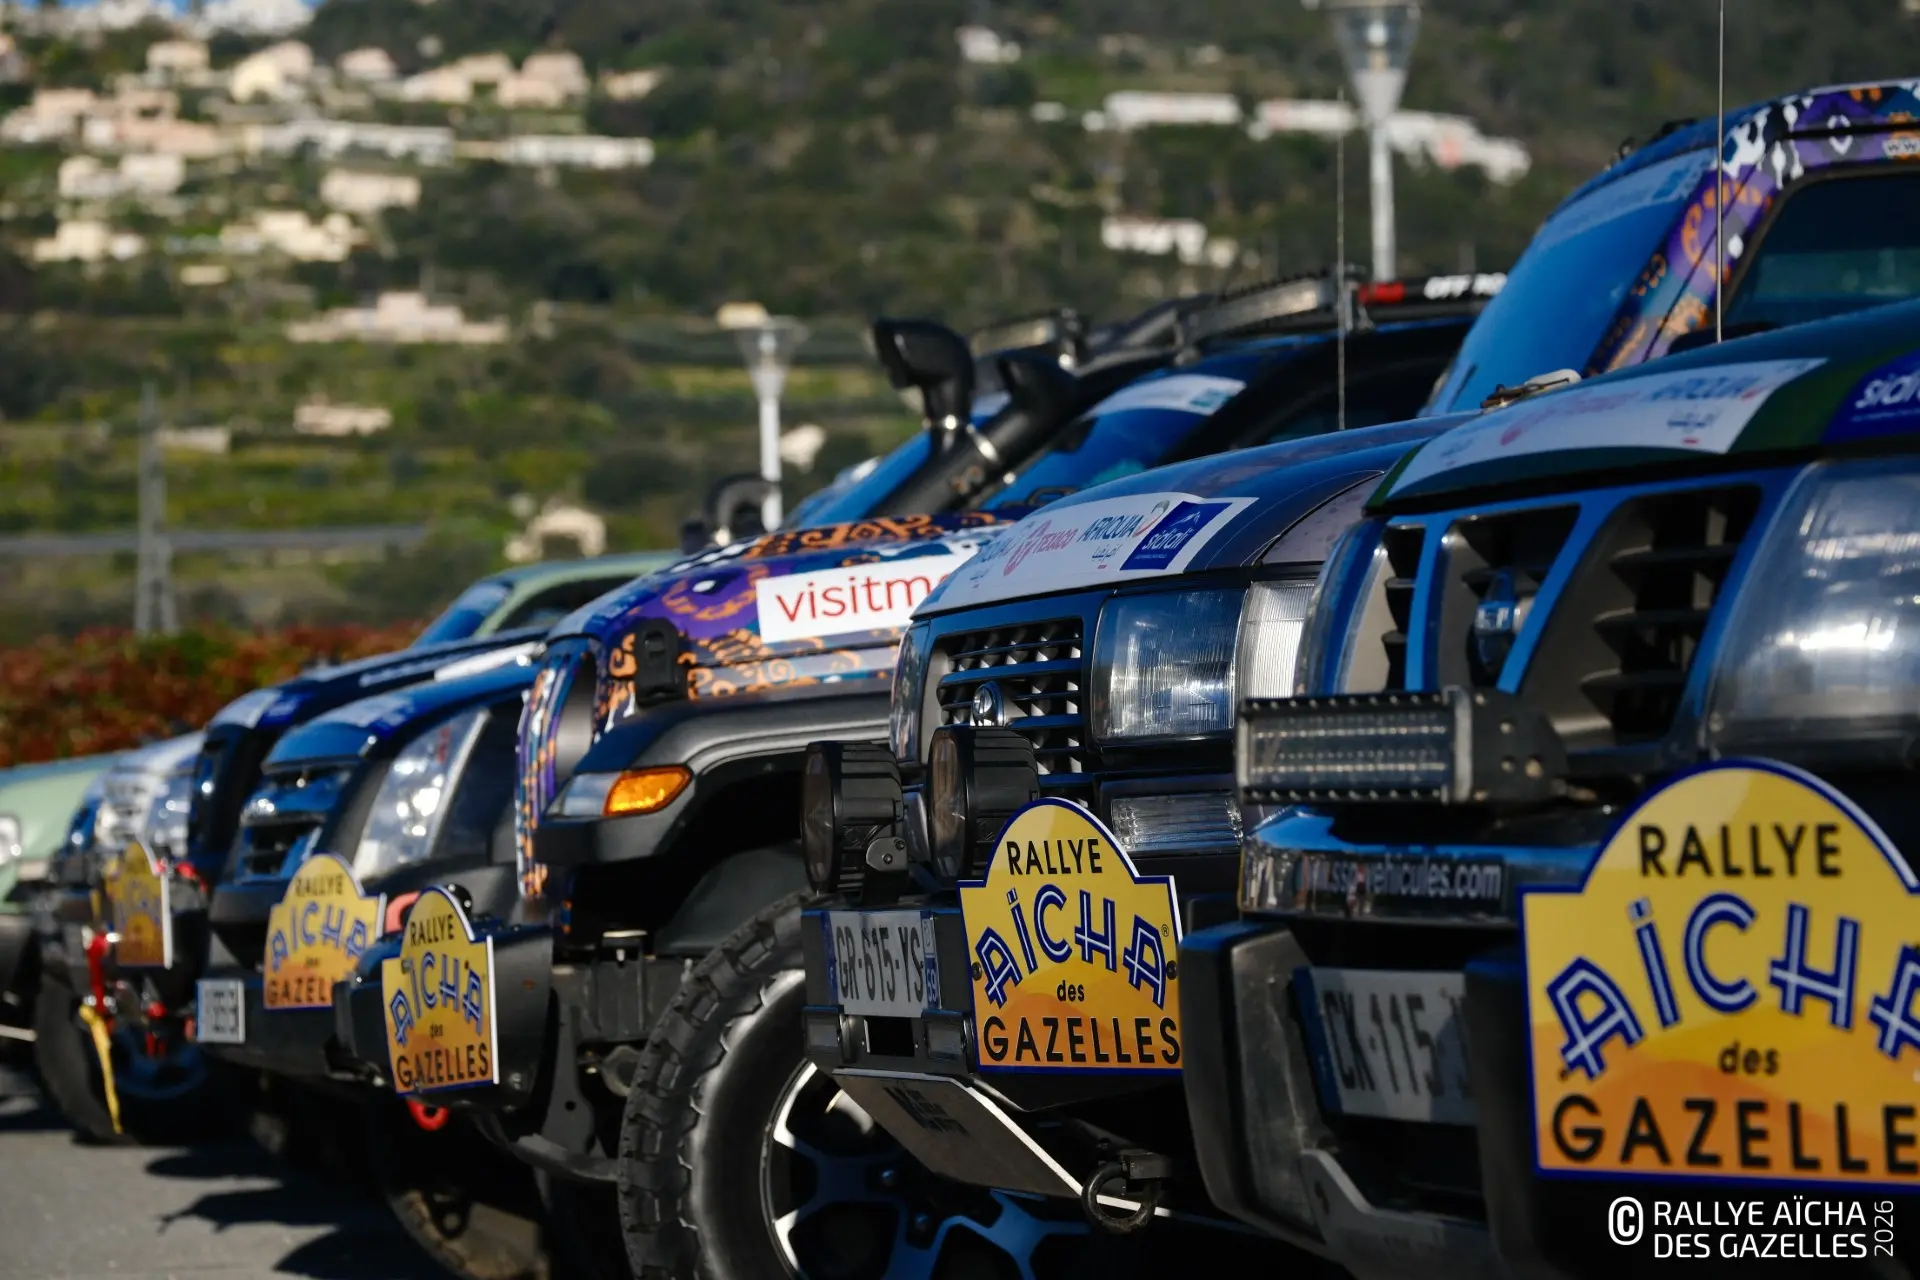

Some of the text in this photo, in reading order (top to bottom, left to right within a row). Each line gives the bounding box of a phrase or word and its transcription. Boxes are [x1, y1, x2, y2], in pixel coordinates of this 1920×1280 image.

[1077, 514, 1145, 543] AFRIQUIA
[1006, 838, 1104, 876] RALLYE
[1638, 824, 1842, 877] RALLYE
[410, 913, 455, 947] RALLYE
[836, 925, 924, 1004] GR-615-YS
[267, 976, 329, 1005] GAZEL
[1056, 980, 1086, 1002] des
[983, 1015, 1181, 1065] GAZELLES
[1718, 1040, 1780, 1076] des
[396, 1042, 489, 1088] GAZELLES
[1552, 1094, 1919, 1176] GAZELLE
